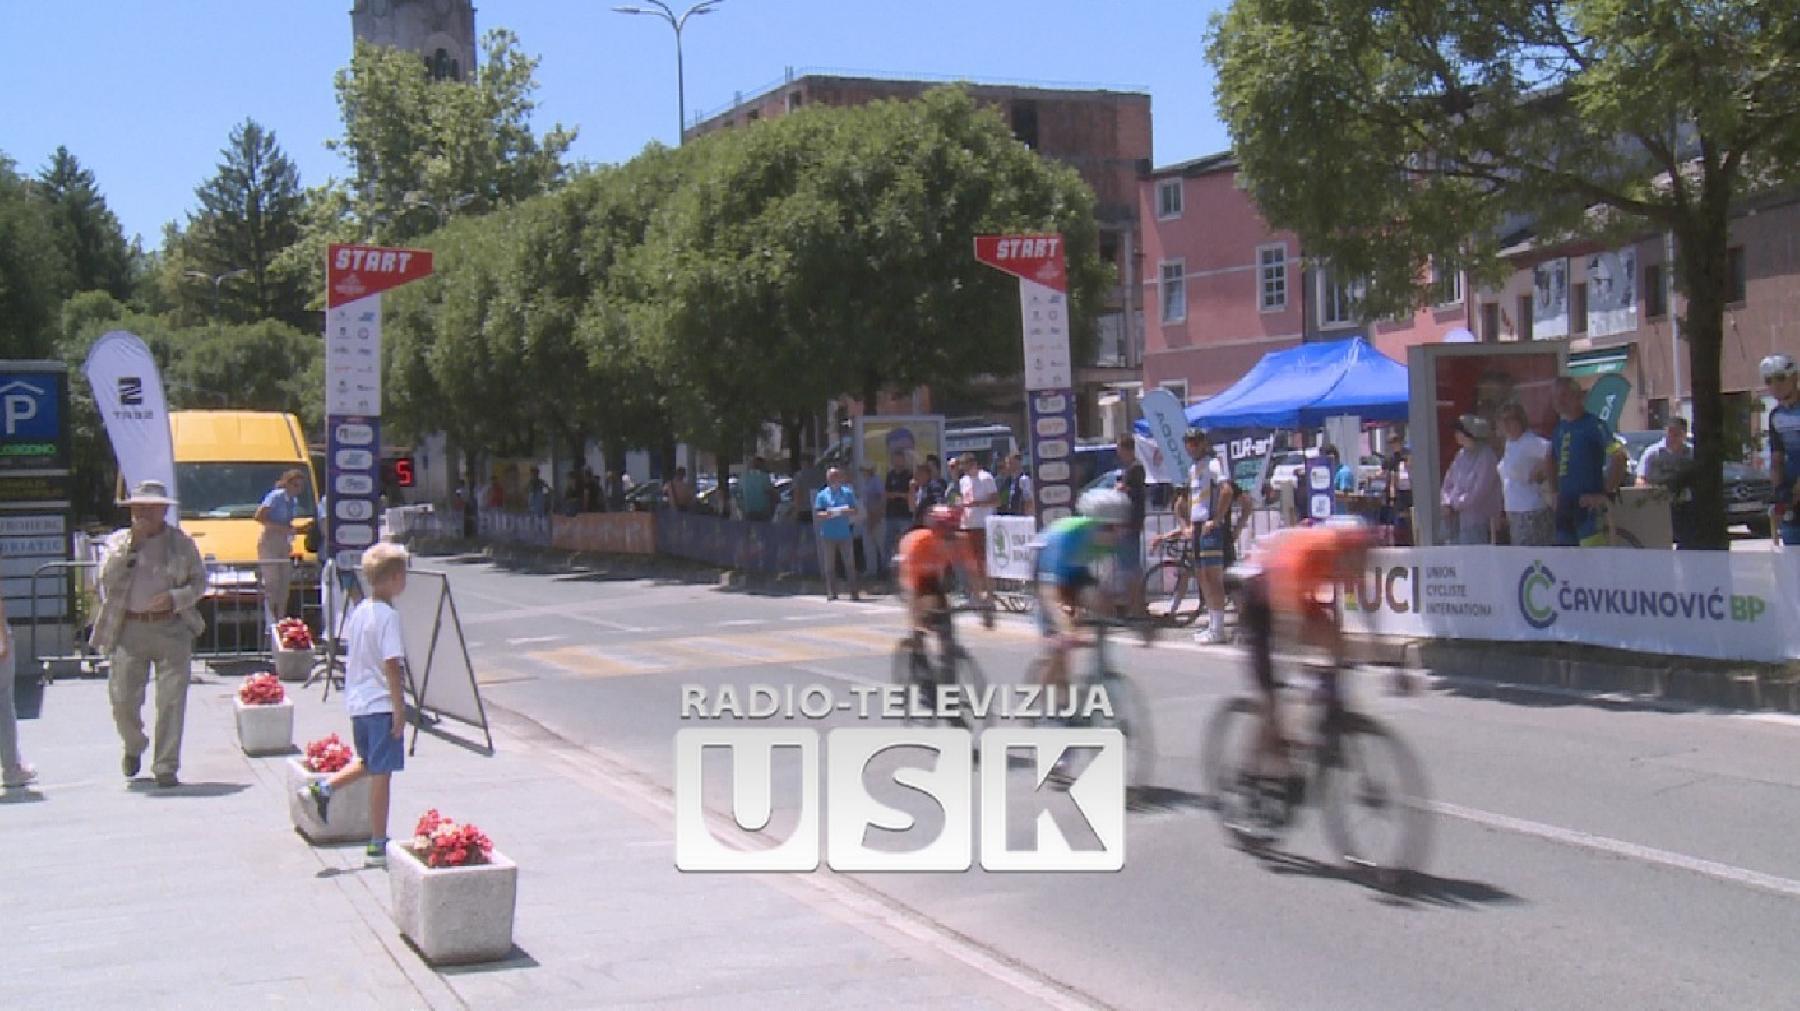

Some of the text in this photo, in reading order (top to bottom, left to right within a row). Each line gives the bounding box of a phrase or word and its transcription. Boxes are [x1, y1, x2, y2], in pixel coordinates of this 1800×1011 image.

[335, 247, 412, 273] START
[996, 238, 1060, 259] START
[5, 395, 37, 434] P
[1426, 566, 1456, 578] UNION
[1358, 566, 1419, 614] UCI
[1426, 584, 1467, 597] CYCLISTE
[1559, 580, 1724, 621] ČAVKUNOVIĆ
[1730, 594, 1766, 622] BP
